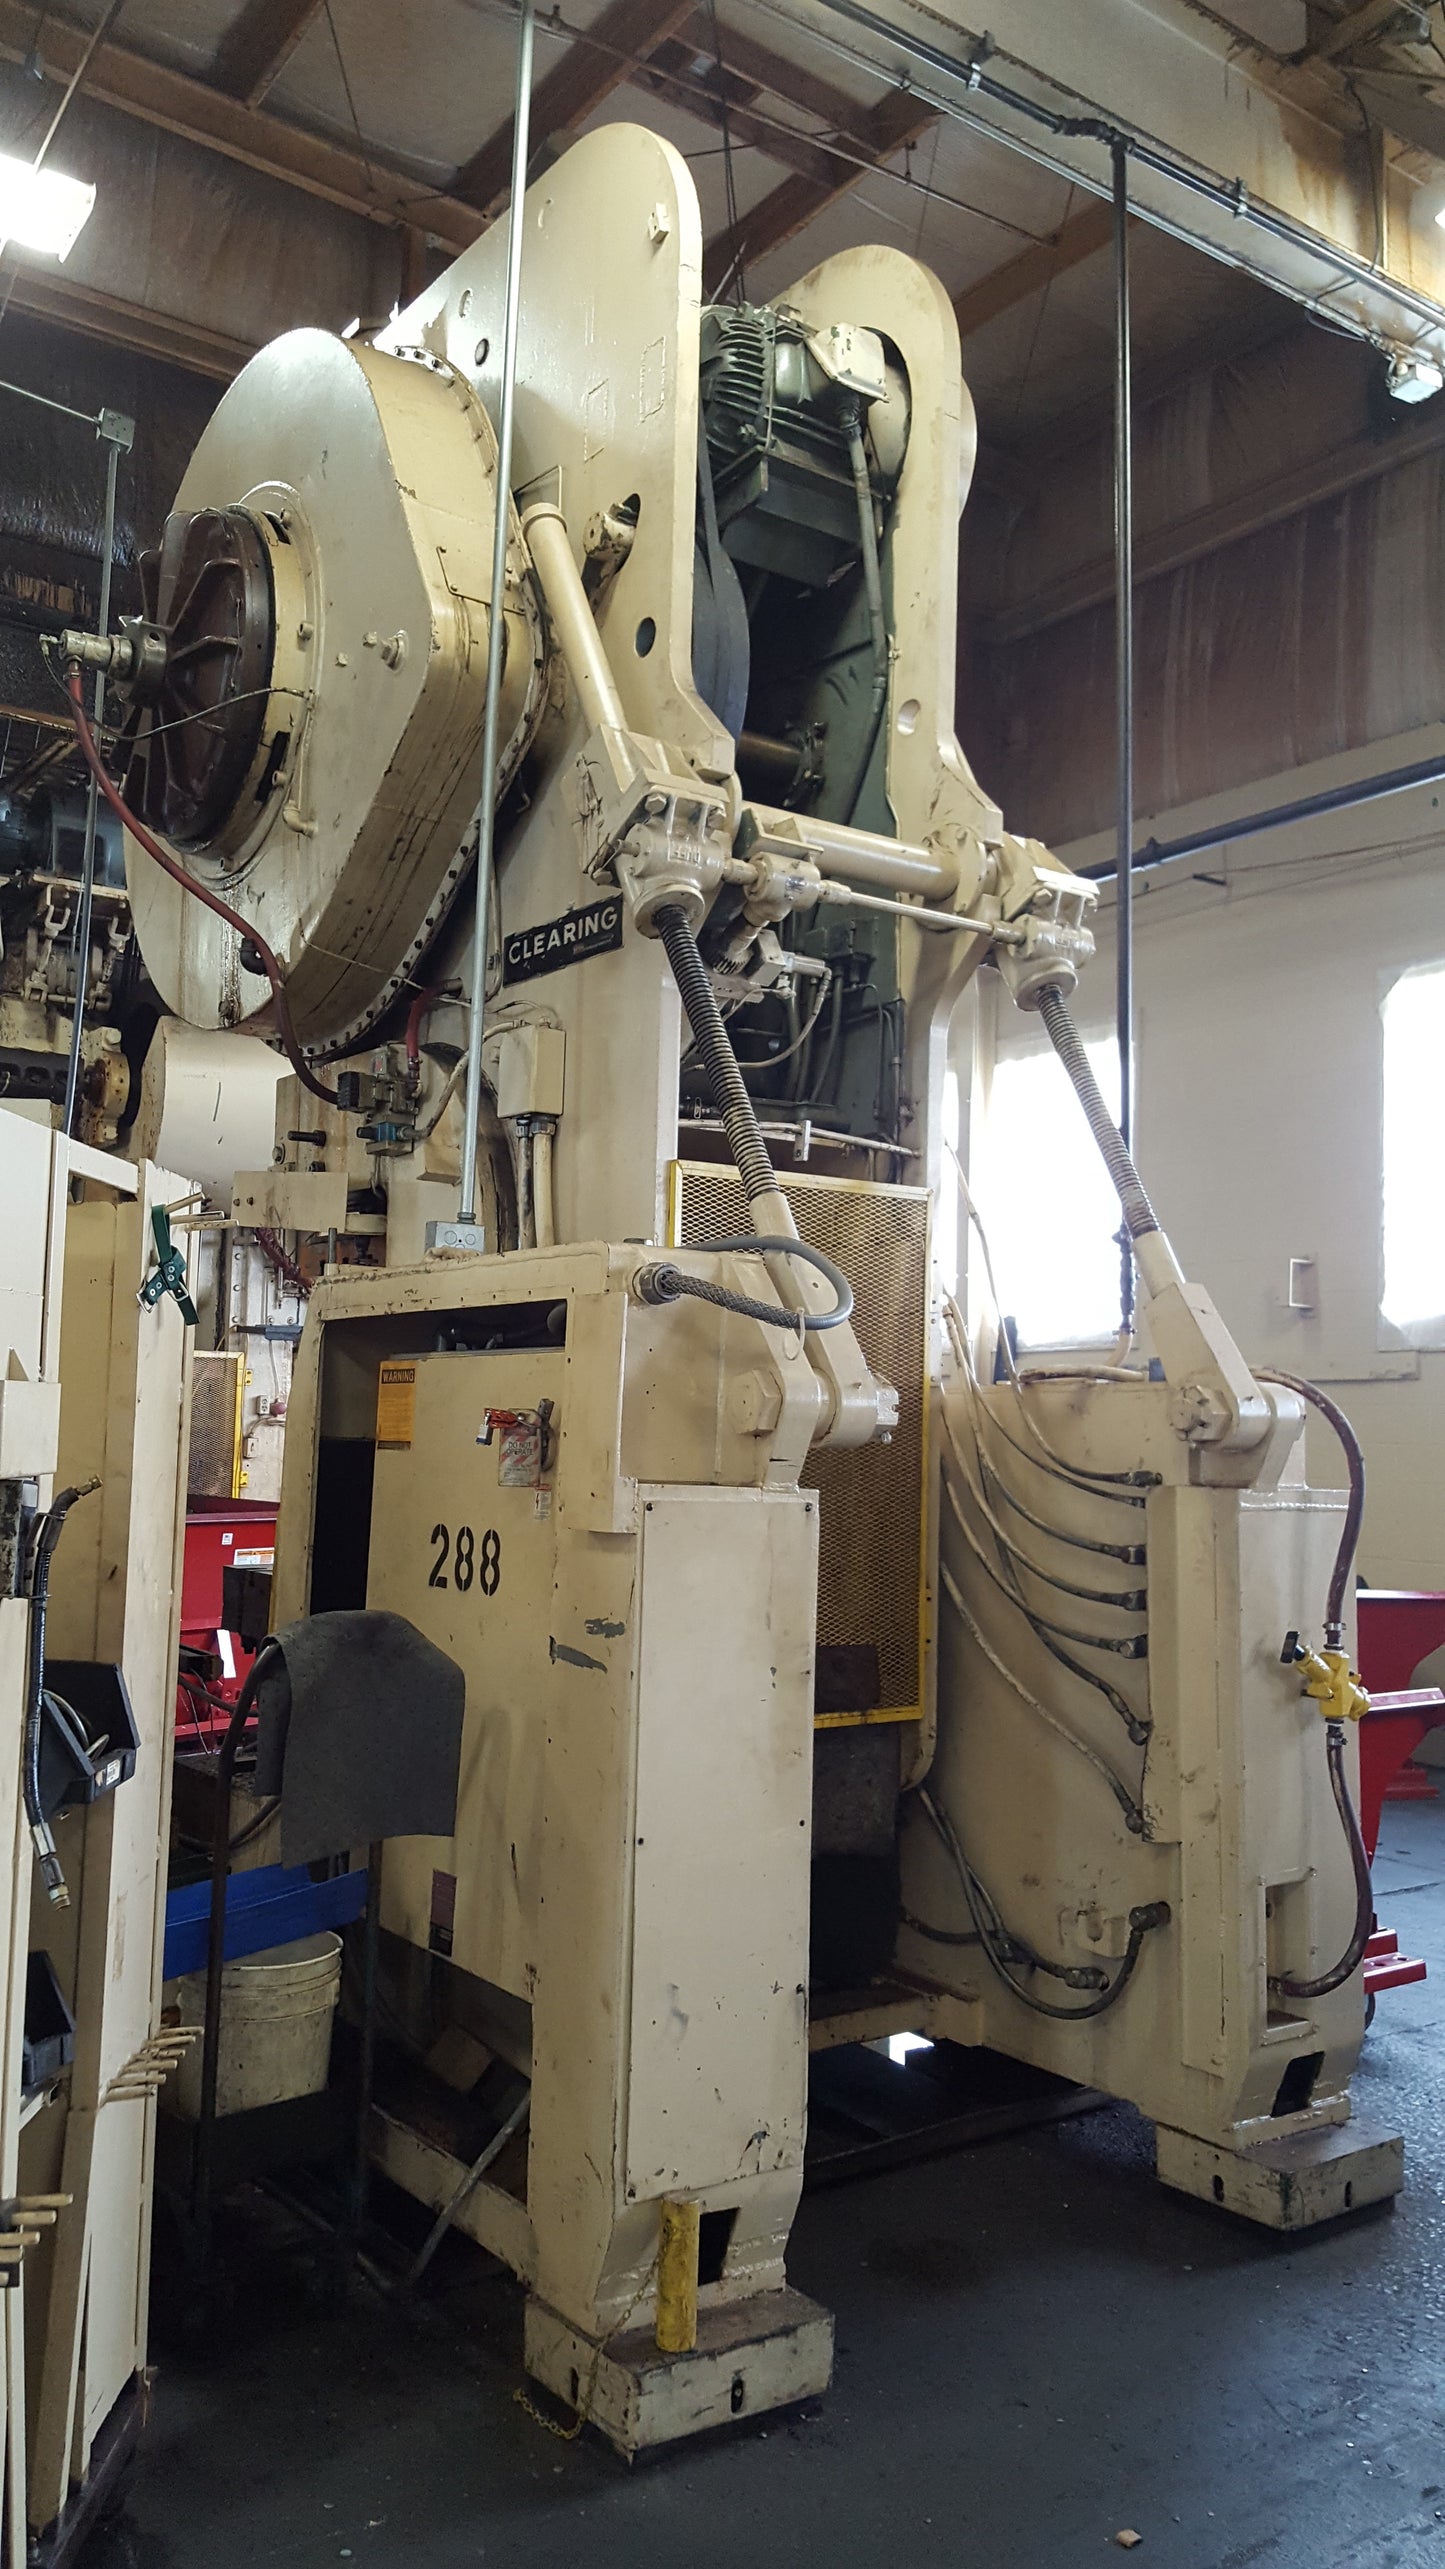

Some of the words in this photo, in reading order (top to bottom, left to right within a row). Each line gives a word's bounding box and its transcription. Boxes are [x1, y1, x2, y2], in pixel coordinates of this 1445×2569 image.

[508, 906, 618, 965] CLEARING
[382, 1370, 414, 1383] WARNING
[508, 1441, 518, 1449] DO
[506, 1448, 534, 1456] OPERATE
[428, 1523, 501, 1597] 288
